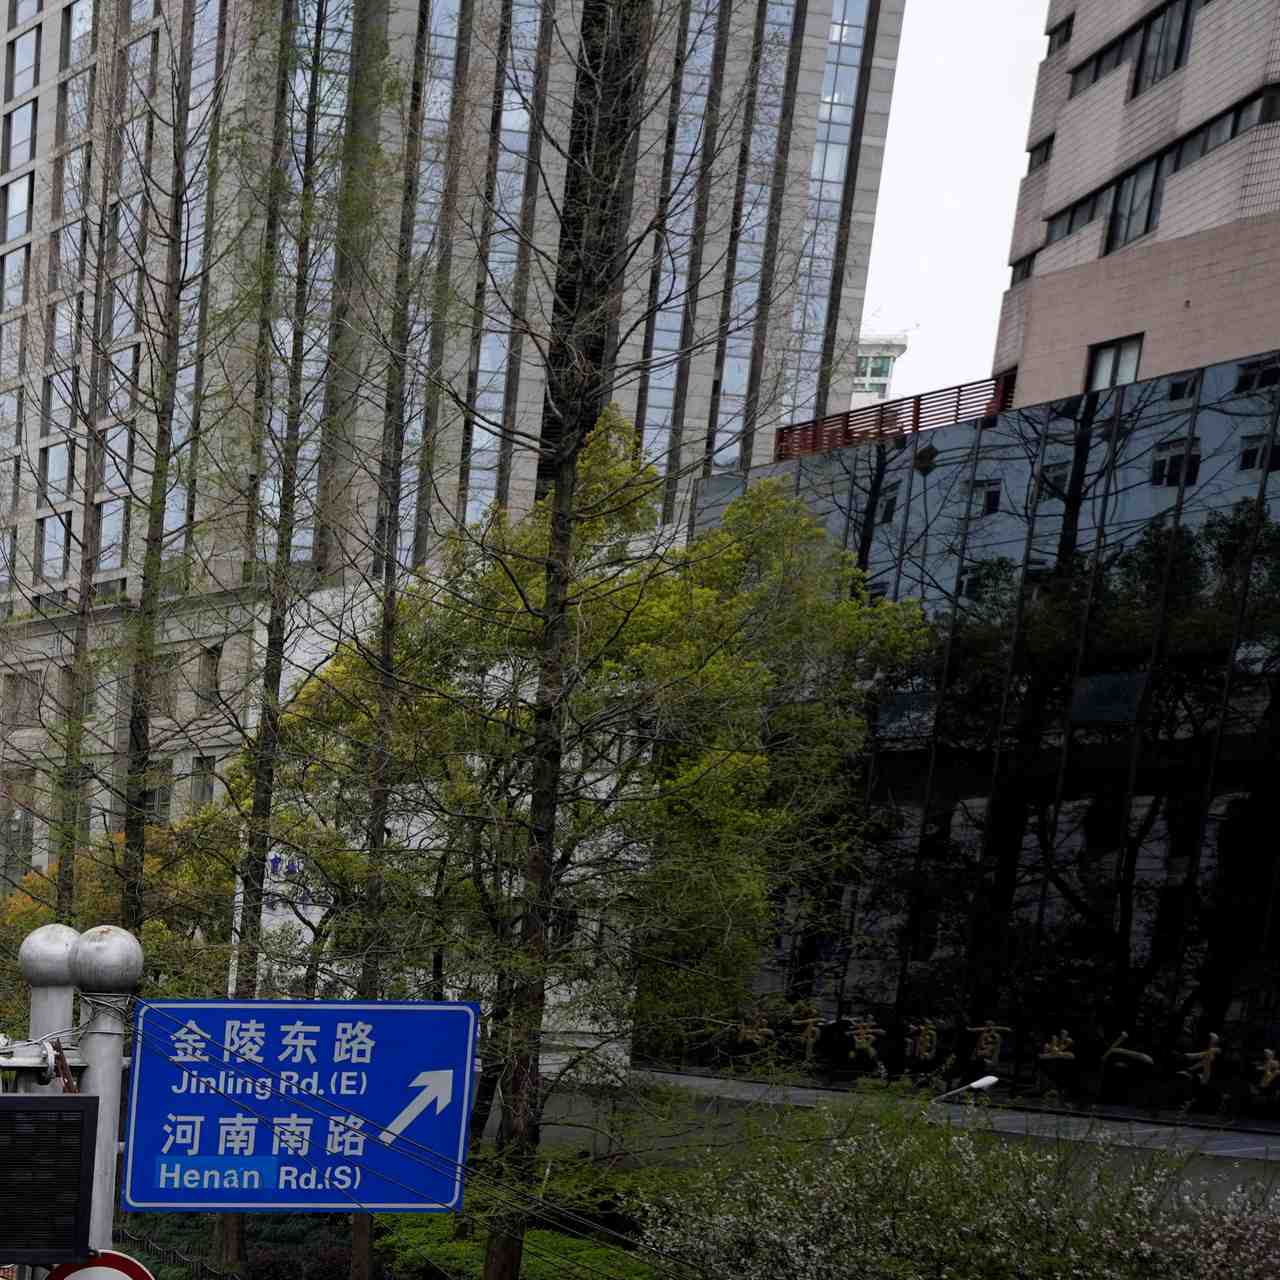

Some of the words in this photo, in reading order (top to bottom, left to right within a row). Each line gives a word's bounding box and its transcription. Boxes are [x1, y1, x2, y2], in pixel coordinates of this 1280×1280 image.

[168, 1019, 376, 1065] 金陵东路
[170, 1071, 272, 1099] Jinling
[161, 1112, 367, 1157] 河南南路
[158, 1163, 261, 1189] Henan
